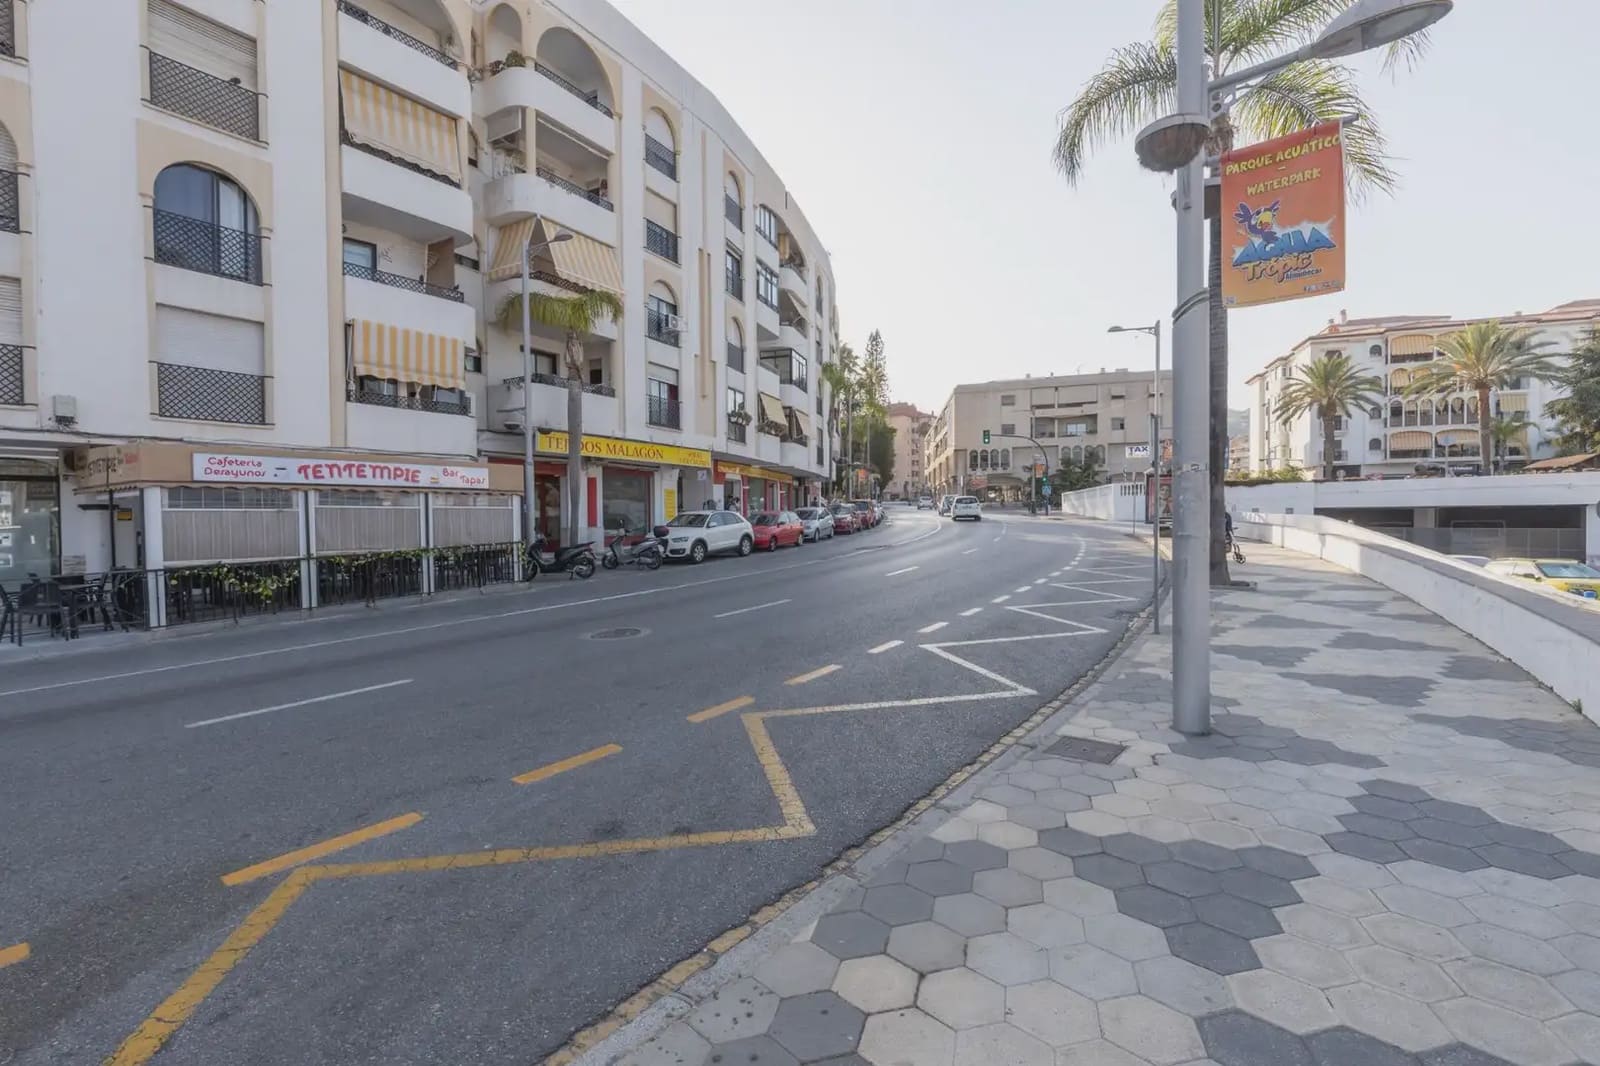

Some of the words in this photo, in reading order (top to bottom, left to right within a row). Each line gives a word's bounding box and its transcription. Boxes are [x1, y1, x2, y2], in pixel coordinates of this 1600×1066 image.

[1225, 153, 1273, 176] PARQUE
[1246, 167, 1321, 196] WATERPARK
[606, 442, 664, 459] MALAGÓN
[442, 467, 458, 477] Bar
[460, 475, 486, 486] Tapas
